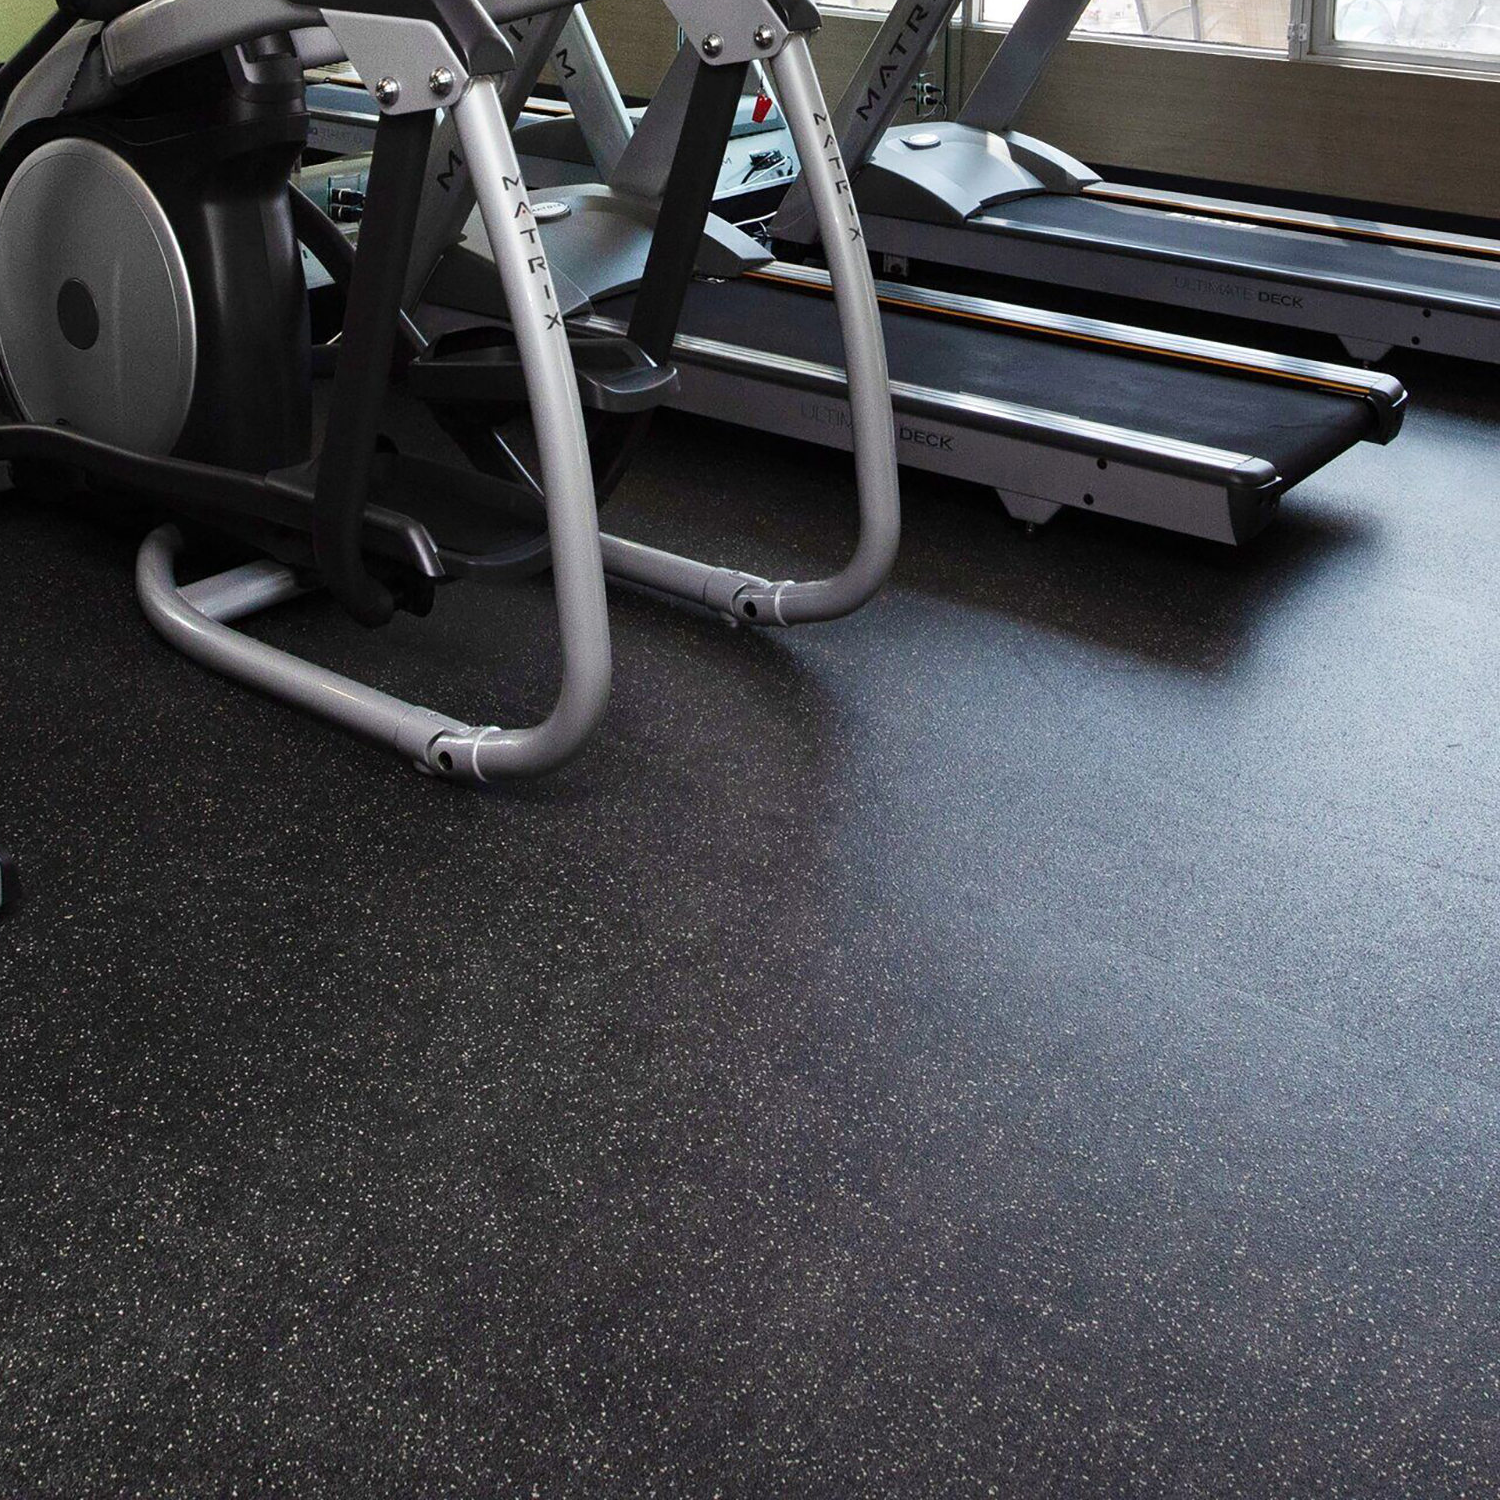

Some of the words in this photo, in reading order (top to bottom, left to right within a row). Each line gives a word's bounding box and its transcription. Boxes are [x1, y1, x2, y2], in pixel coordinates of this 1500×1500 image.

[812, 111, 864, 242] MATRIX
[501, 175, 562, 331] MATRIX
[1258, 290, 1304, 309] DECK
[900, 423, 954, 451] DECK
